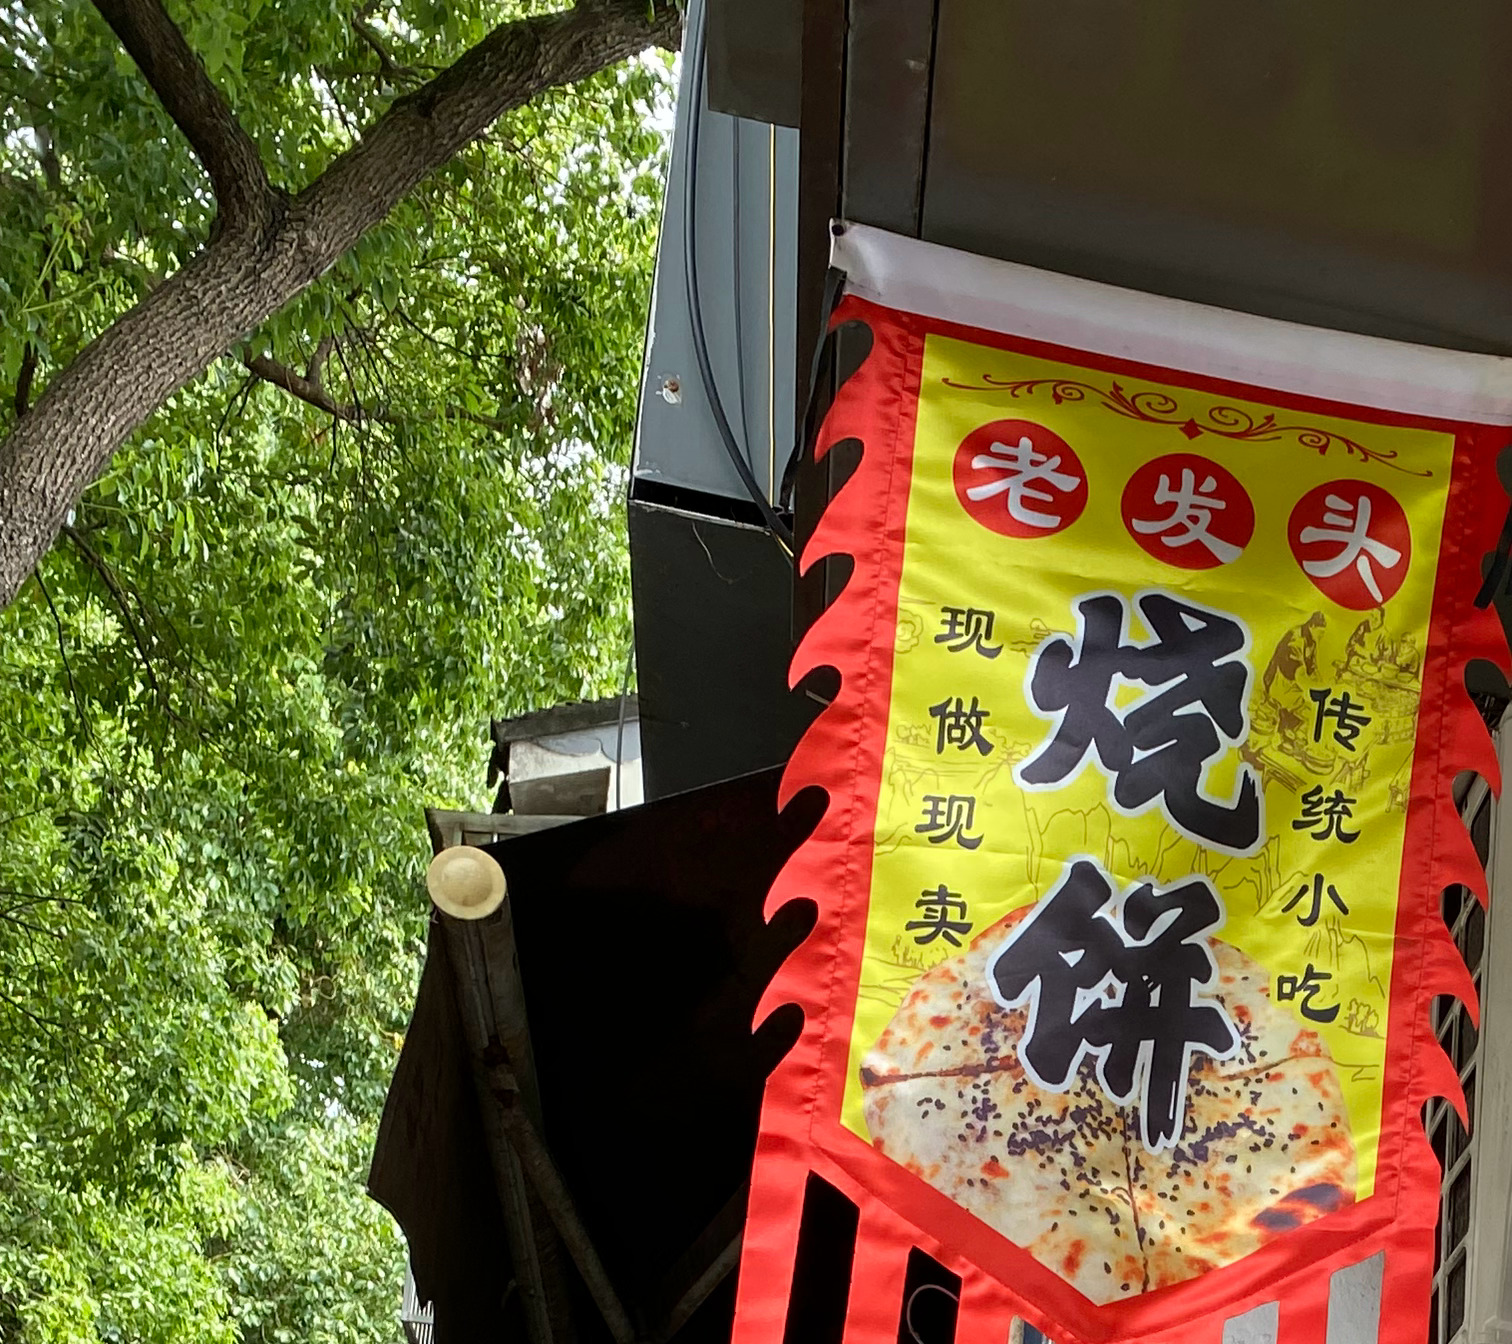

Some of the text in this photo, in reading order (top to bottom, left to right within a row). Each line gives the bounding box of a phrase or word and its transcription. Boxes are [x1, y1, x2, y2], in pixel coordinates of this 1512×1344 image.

[966, 434, 1402, 602] 老发头
[904, 604, 1003, 948] 现做现卖
[990, 591, 1267, 1154] 烧饼
[1276, 685, 1372, 1026] 传统小吃
